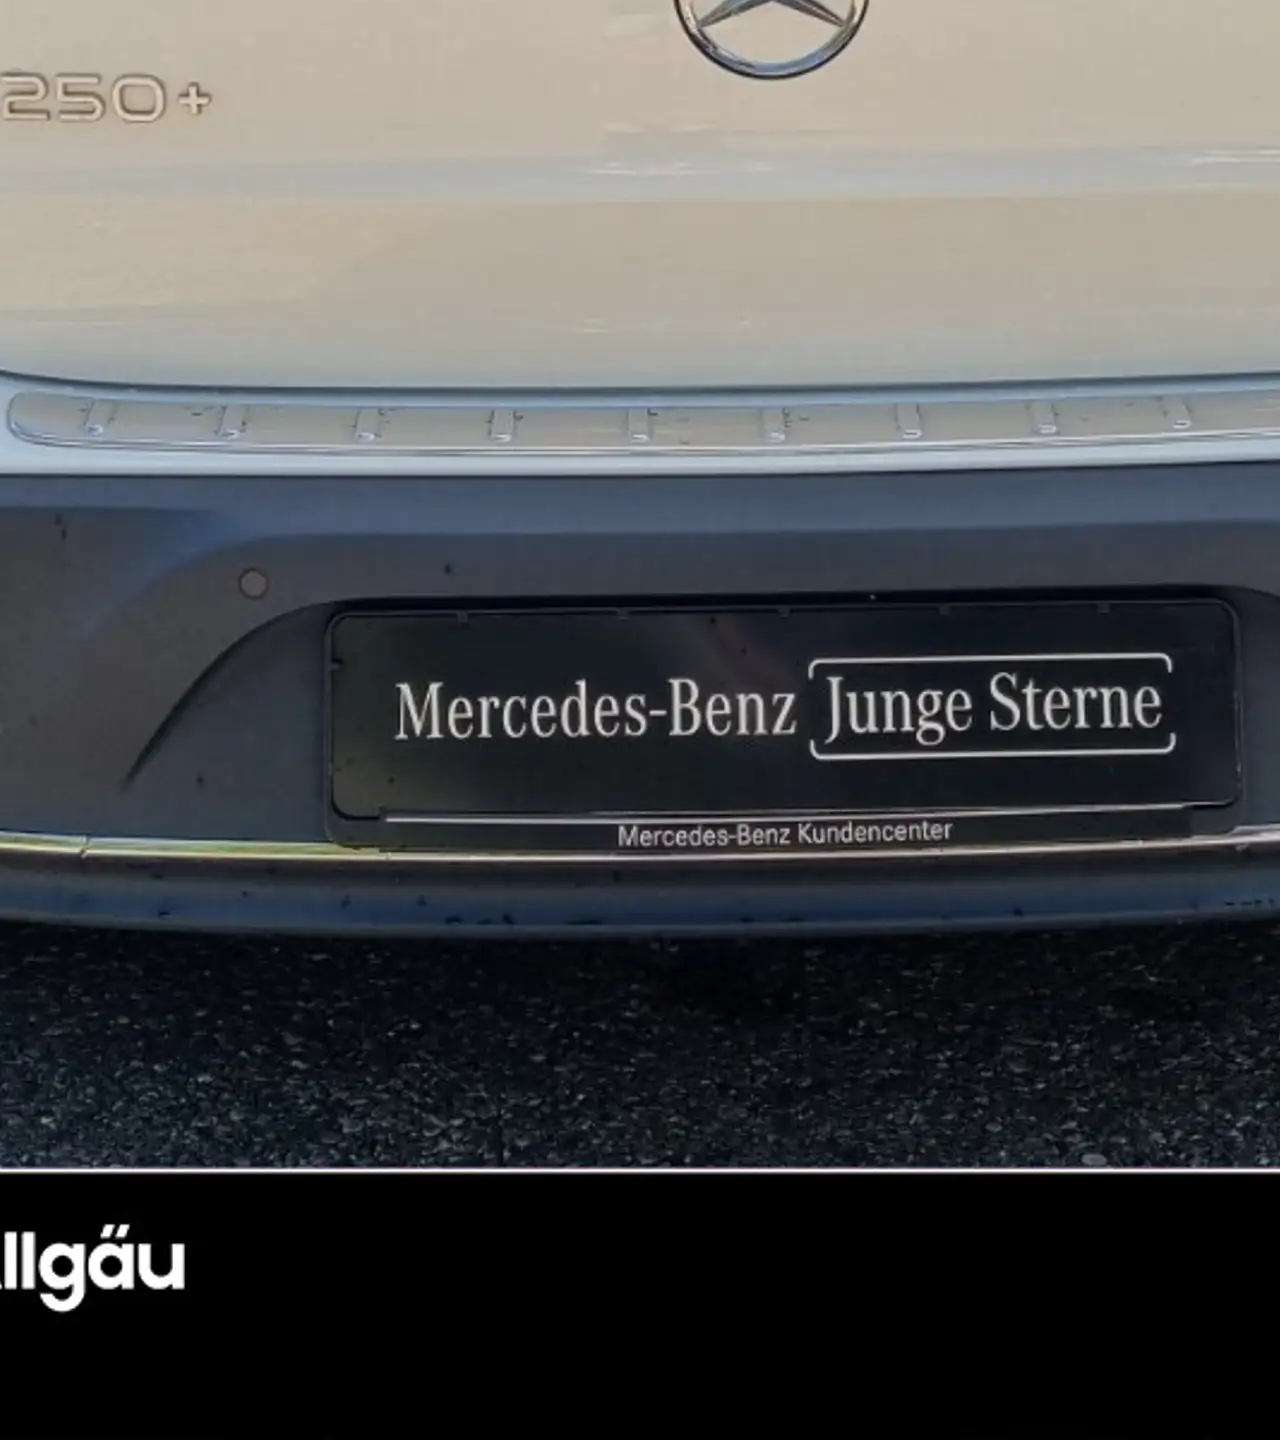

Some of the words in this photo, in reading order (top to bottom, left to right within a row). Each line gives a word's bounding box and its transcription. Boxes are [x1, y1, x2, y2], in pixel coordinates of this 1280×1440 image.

[394, 678, 798, 740] Mercedes-Benz
[824, 675, 973, 746] Junge
[989, 672, 1162, 731] Sterne
[618, 823, 791, 847] Mercedes-Benz
[797, 819, 954, 844] Kundencenter
